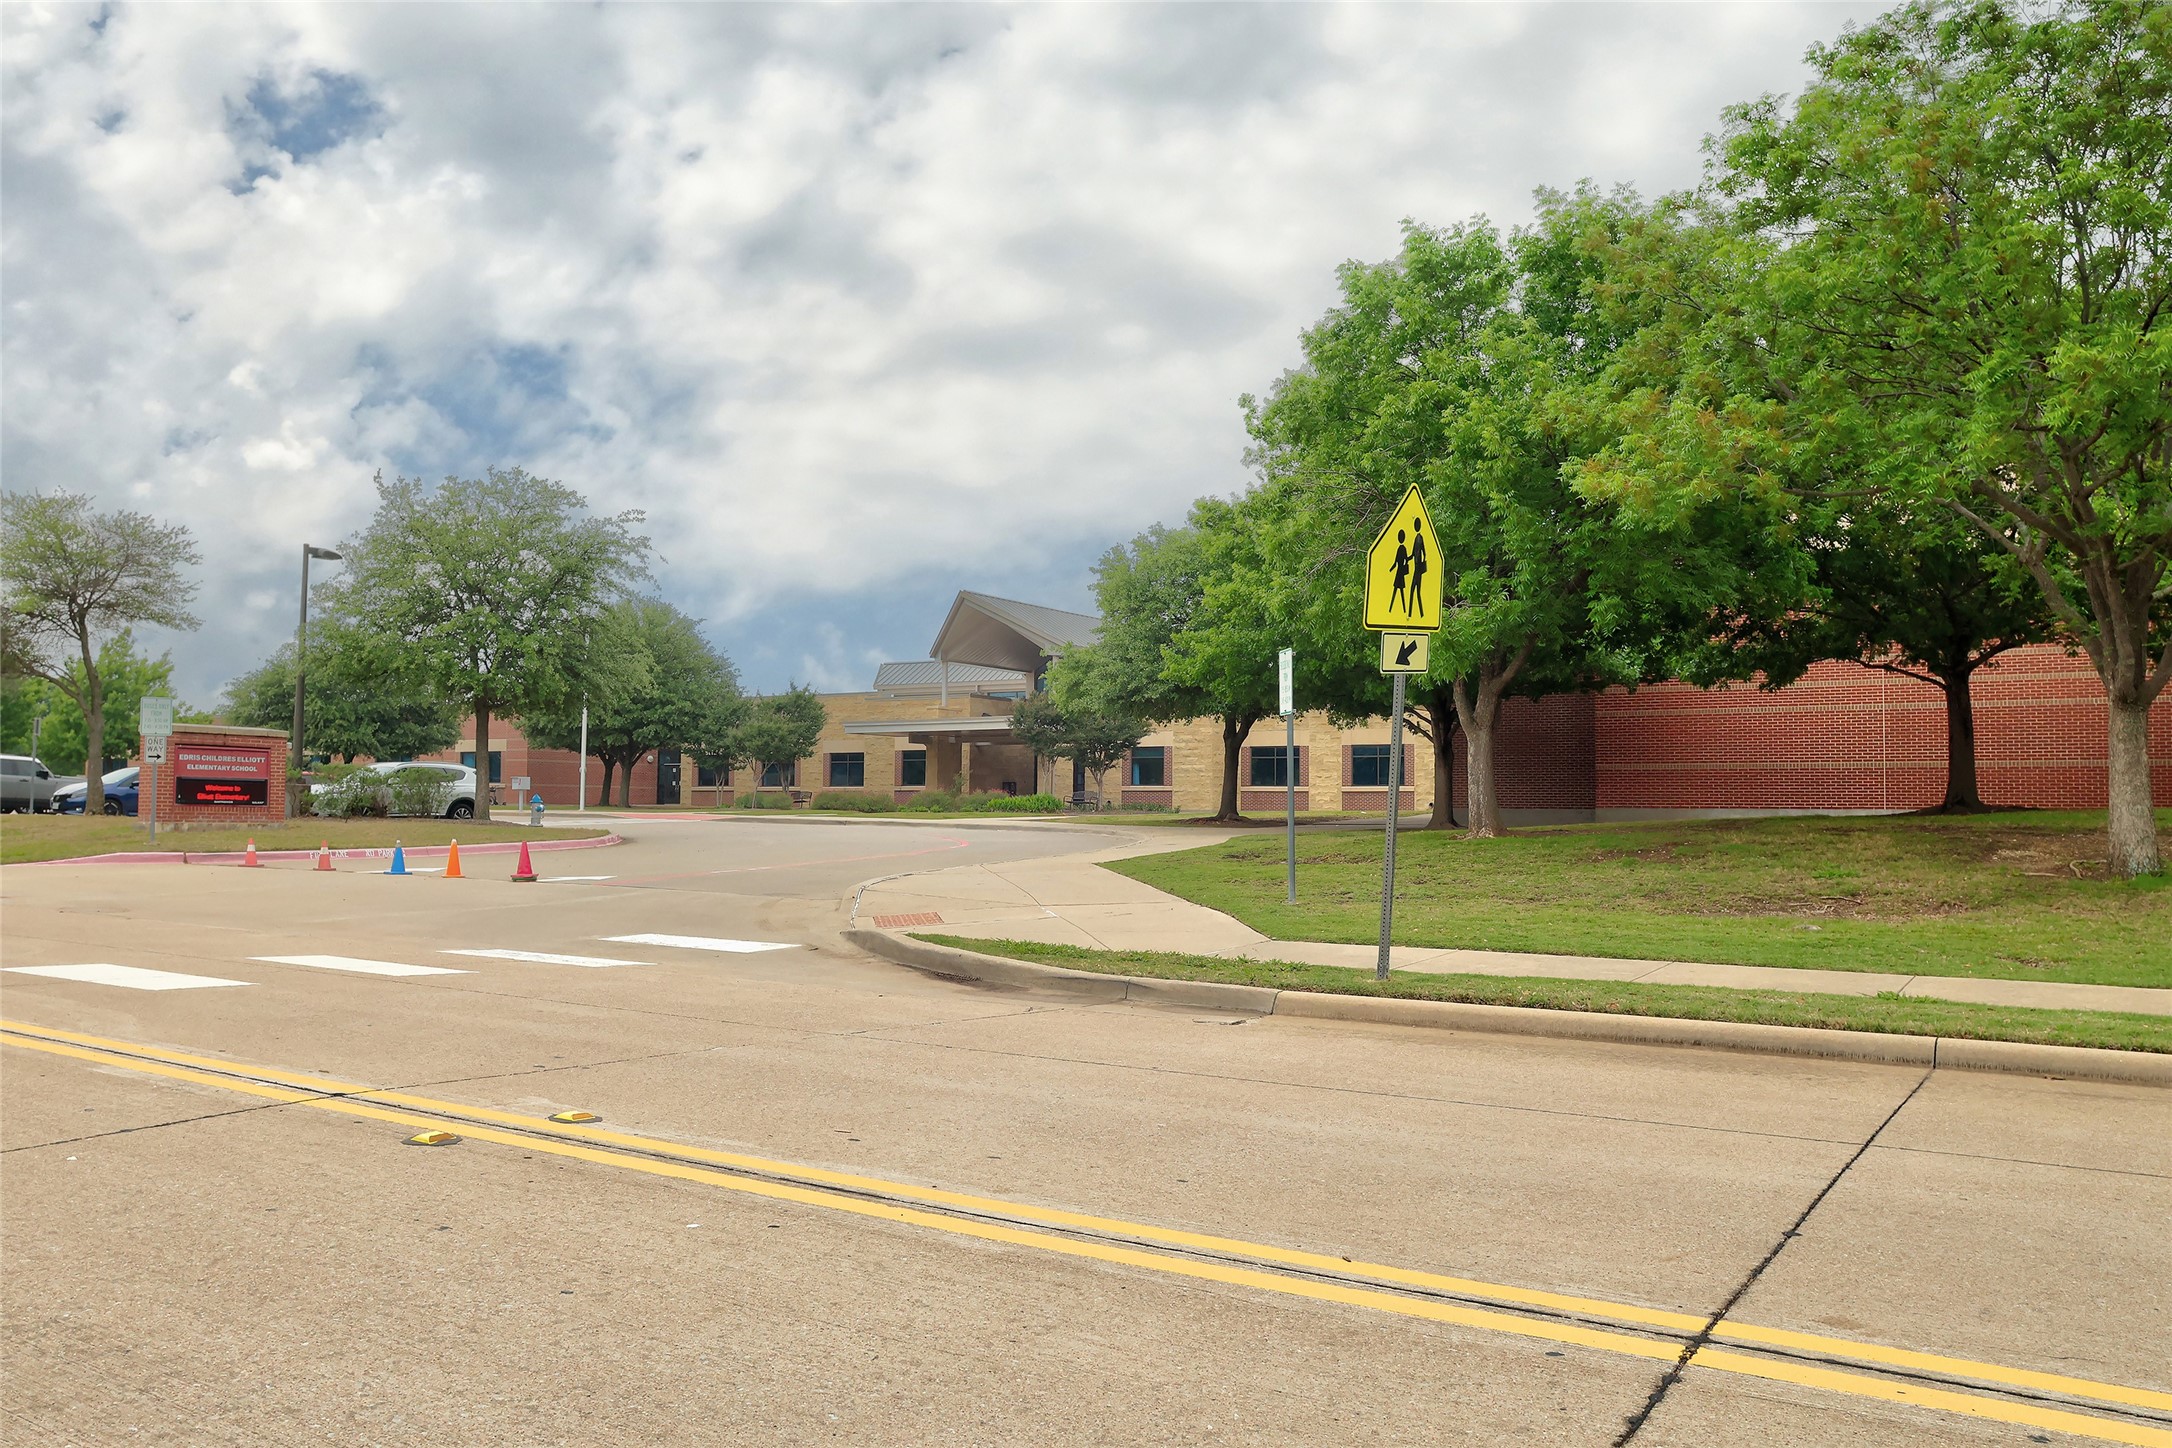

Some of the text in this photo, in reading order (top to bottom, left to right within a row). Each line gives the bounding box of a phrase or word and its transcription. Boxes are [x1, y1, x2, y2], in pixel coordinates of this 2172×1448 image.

[147, 738, 164, 746] ONE
[179, 753, 201, 761] EDRIS
[201, 754, 237, 763] CHILDRES
[187, 763, 230, 772] ELEMENTARY
[331, 850, 349, 858] LANE
[366, 849, 406, 858] NO PARK
